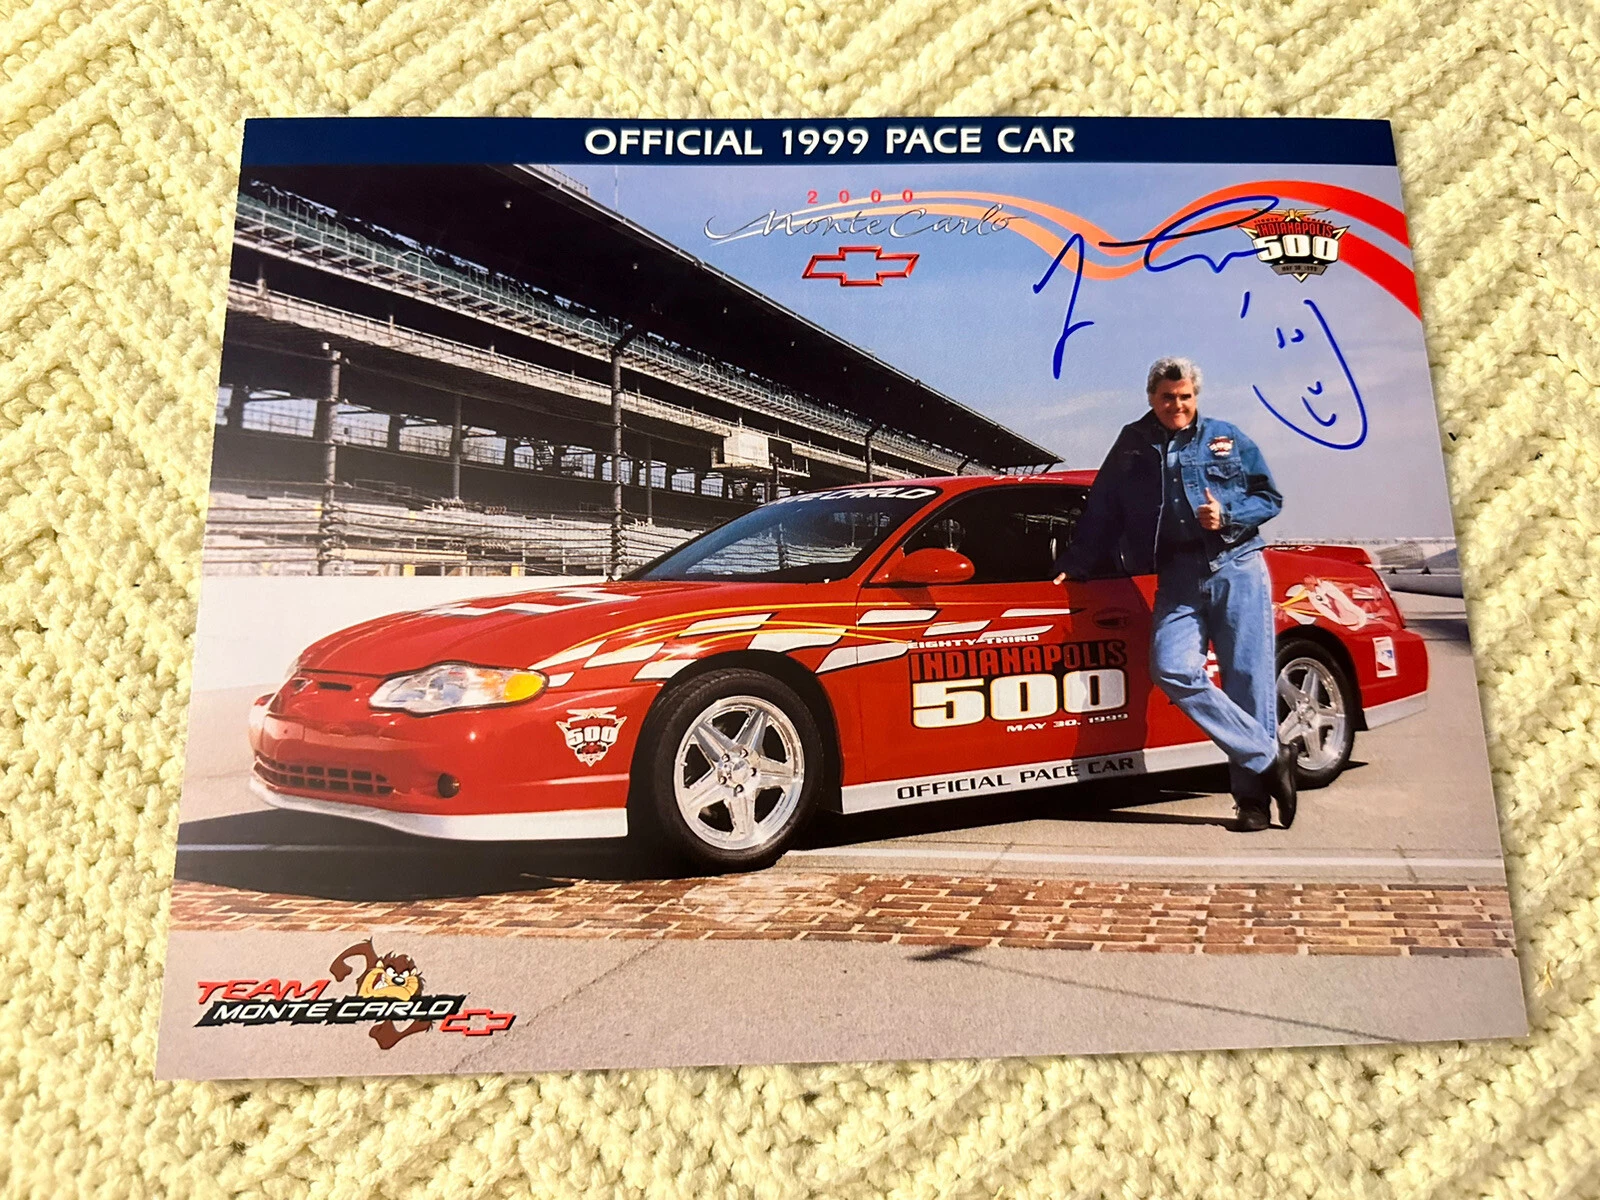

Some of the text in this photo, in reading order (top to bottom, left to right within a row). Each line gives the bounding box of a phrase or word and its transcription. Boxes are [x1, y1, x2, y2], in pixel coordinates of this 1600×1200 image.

[584, 126, 1076, 157] OFFICIAL 1999 PACE CAR
[704, 203, 1030, 239] Monte Carlo
[1256, 221, 1334, 237] INDIANAPOLIS
[1253, 235, 1338, 261] 500
[909, 640, 1128, 680] INDIANAPOLIS
[911, 668, 1127, 729] 500
[566, 726, 617, 746] 500
[1006, 722, 1047, 733] MAY
[1088, 713, 1129, 724] 1999
[897, 757, 1135, 801] OFFICIAL PACE CAR
[197, 978, 331, 1005] TEAM
[213, 1000, 455, 1020] MONTE CARLO
